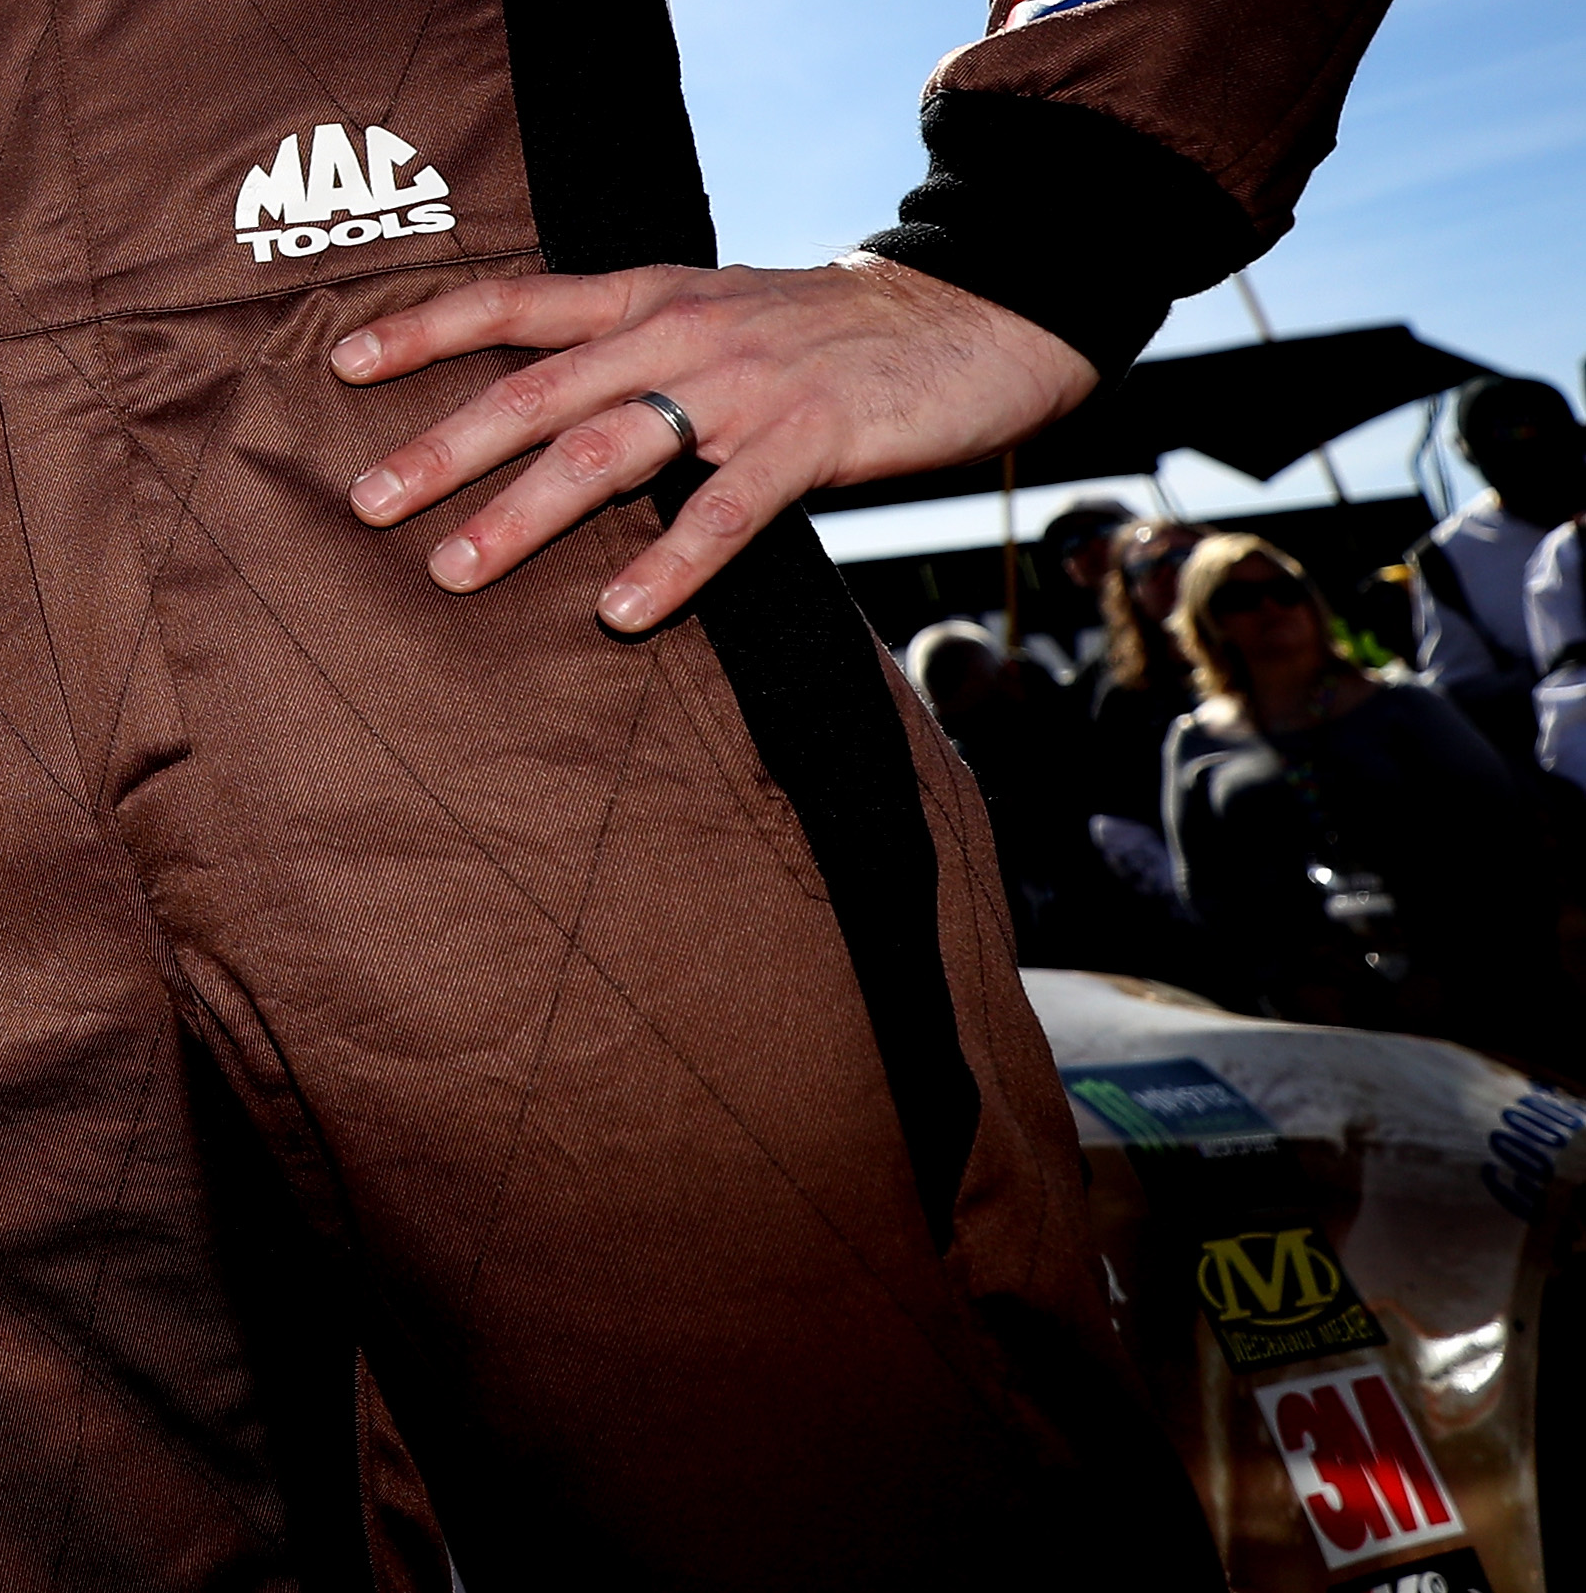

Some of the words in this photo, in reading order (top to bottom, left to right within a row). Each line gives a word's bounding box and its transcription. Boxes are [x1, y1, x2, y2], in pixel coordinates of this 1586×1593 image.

[235, 123, 450, 230] MAC
[235, 202, 457, 264] TOOLS
[1276, 1374, 1452, 1553] 3M
